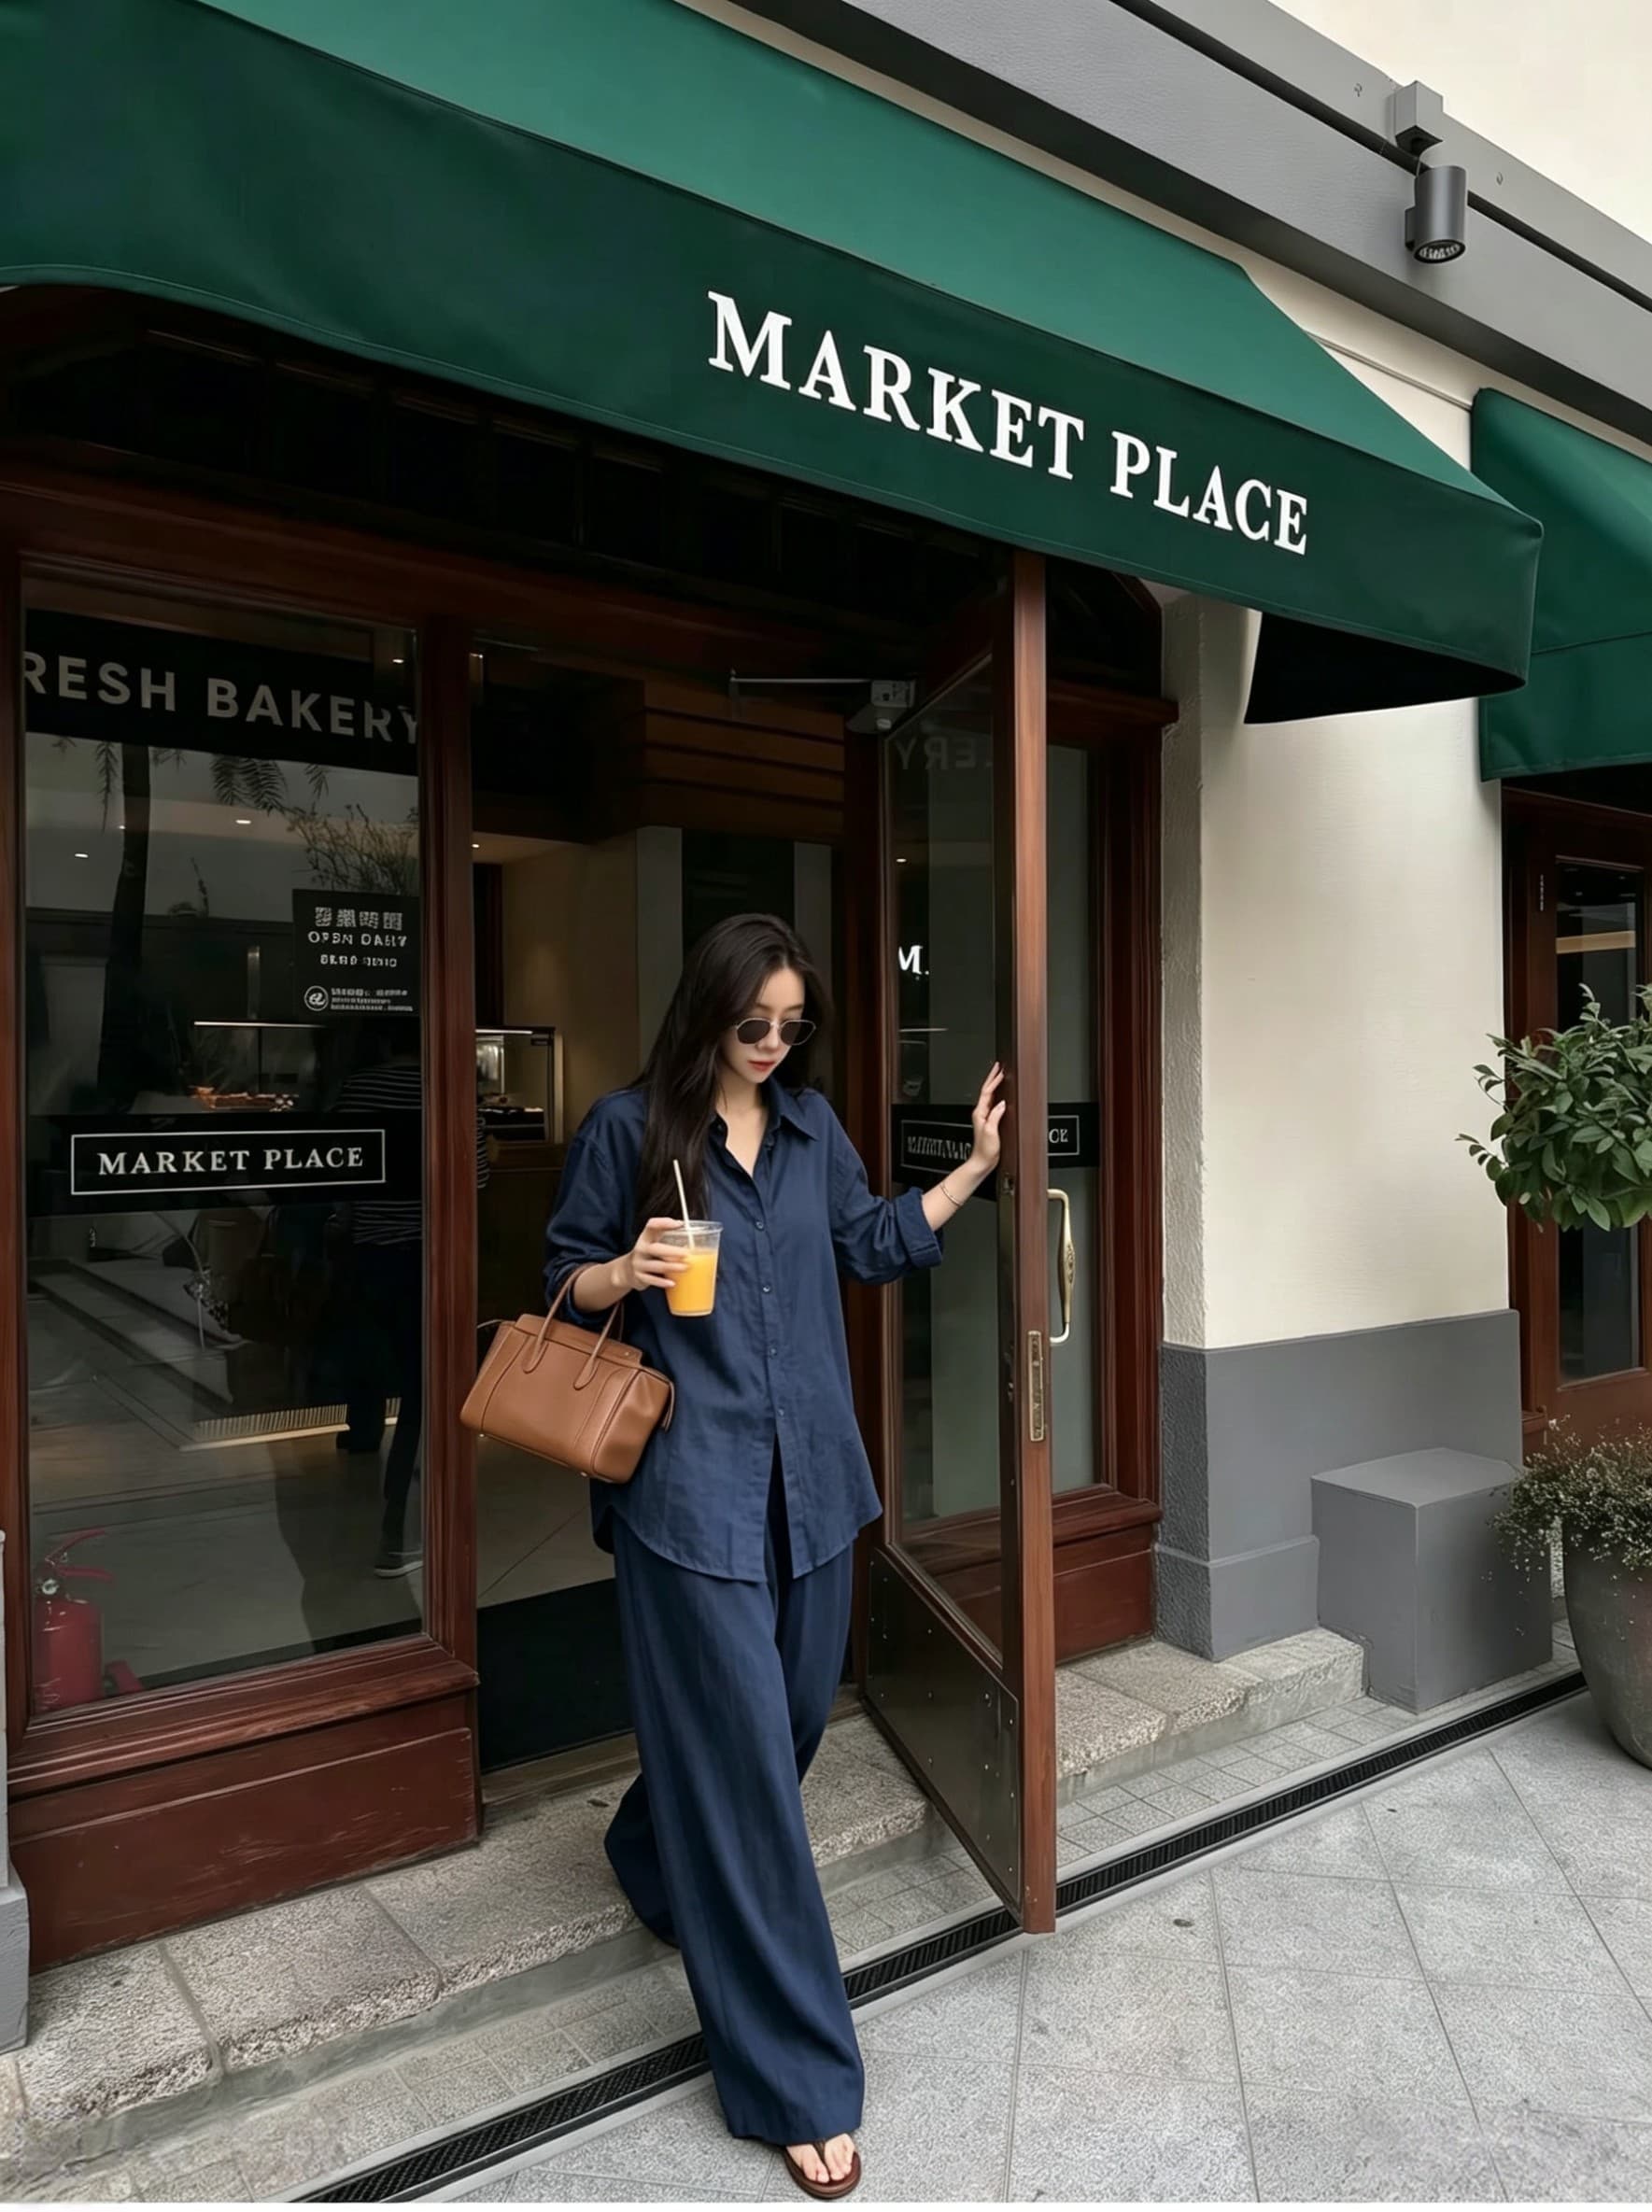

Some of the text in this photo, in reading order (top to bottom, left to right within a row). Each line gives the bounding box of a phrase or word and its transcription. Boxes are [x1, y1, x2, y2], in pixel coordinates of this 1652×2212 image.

[708, 290, 1307, 556] MARKET PLACE
[206, 678, 417, 744] BAKERY
[97, 1147, 364, 1176] MARKET PLACE
